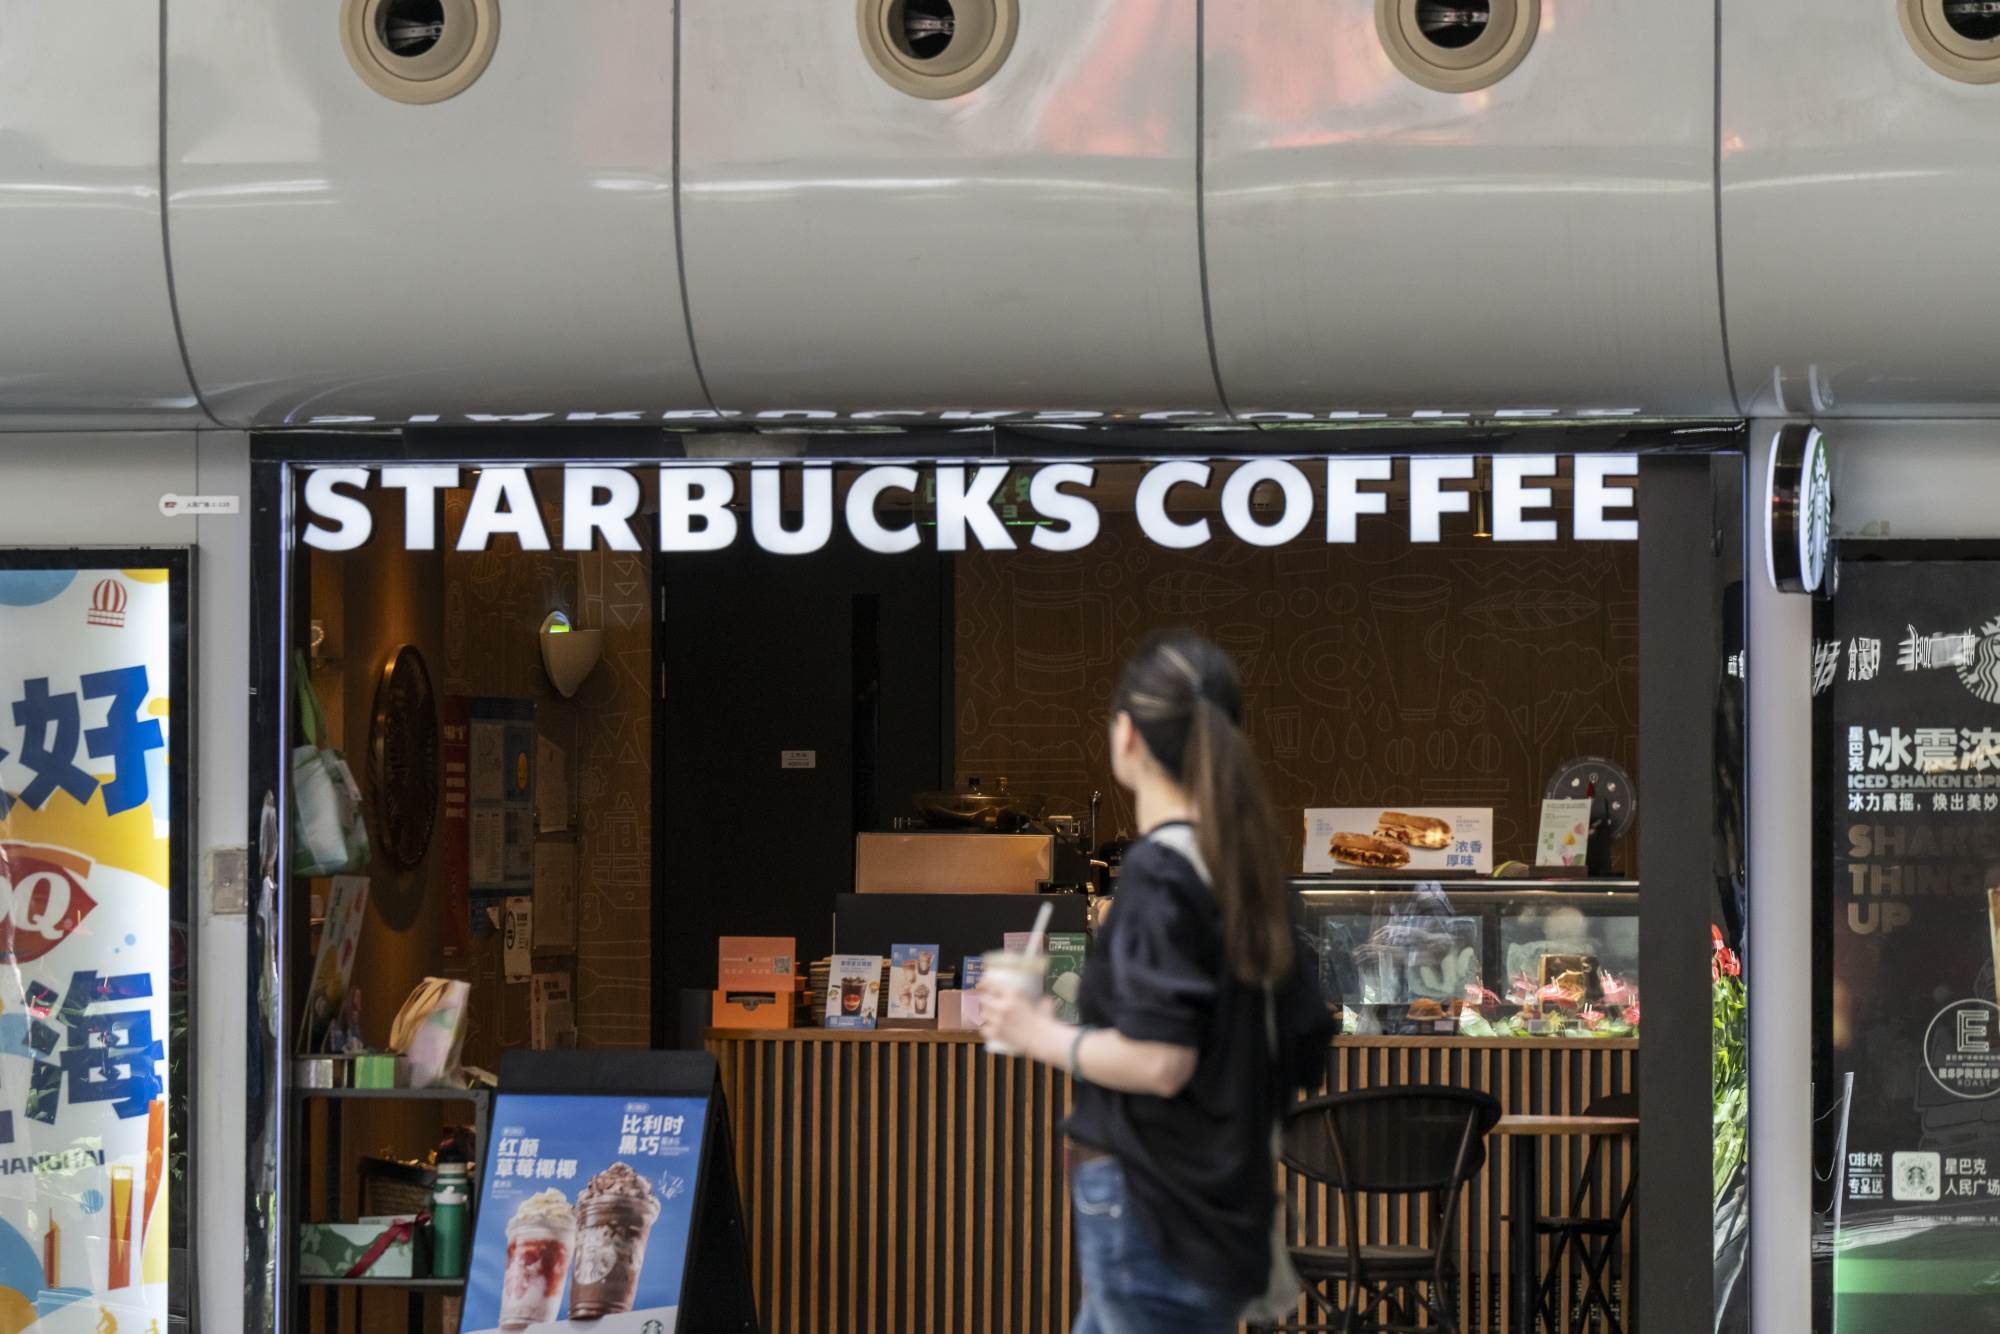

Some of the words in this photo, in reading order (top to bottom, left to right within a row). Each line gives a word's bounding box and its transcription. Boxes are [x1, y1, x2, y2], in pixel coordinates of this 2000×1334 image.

[302, 462, 1101, 555] STARBUCKS
[1135, 454, 1640, 549] COFFEE
[0, 665, 164, 816] 好
[1847, 774, 1889, 789] ICED
[1890, 774, 1960, 789] SHAKEN
[1847, 902, 1912, 935] UP
[0, 969, 165, 1144] 海
[620, 1114, 684, 1135] 比利时
[1944, 1157, 1988, 1176] 星巴克
